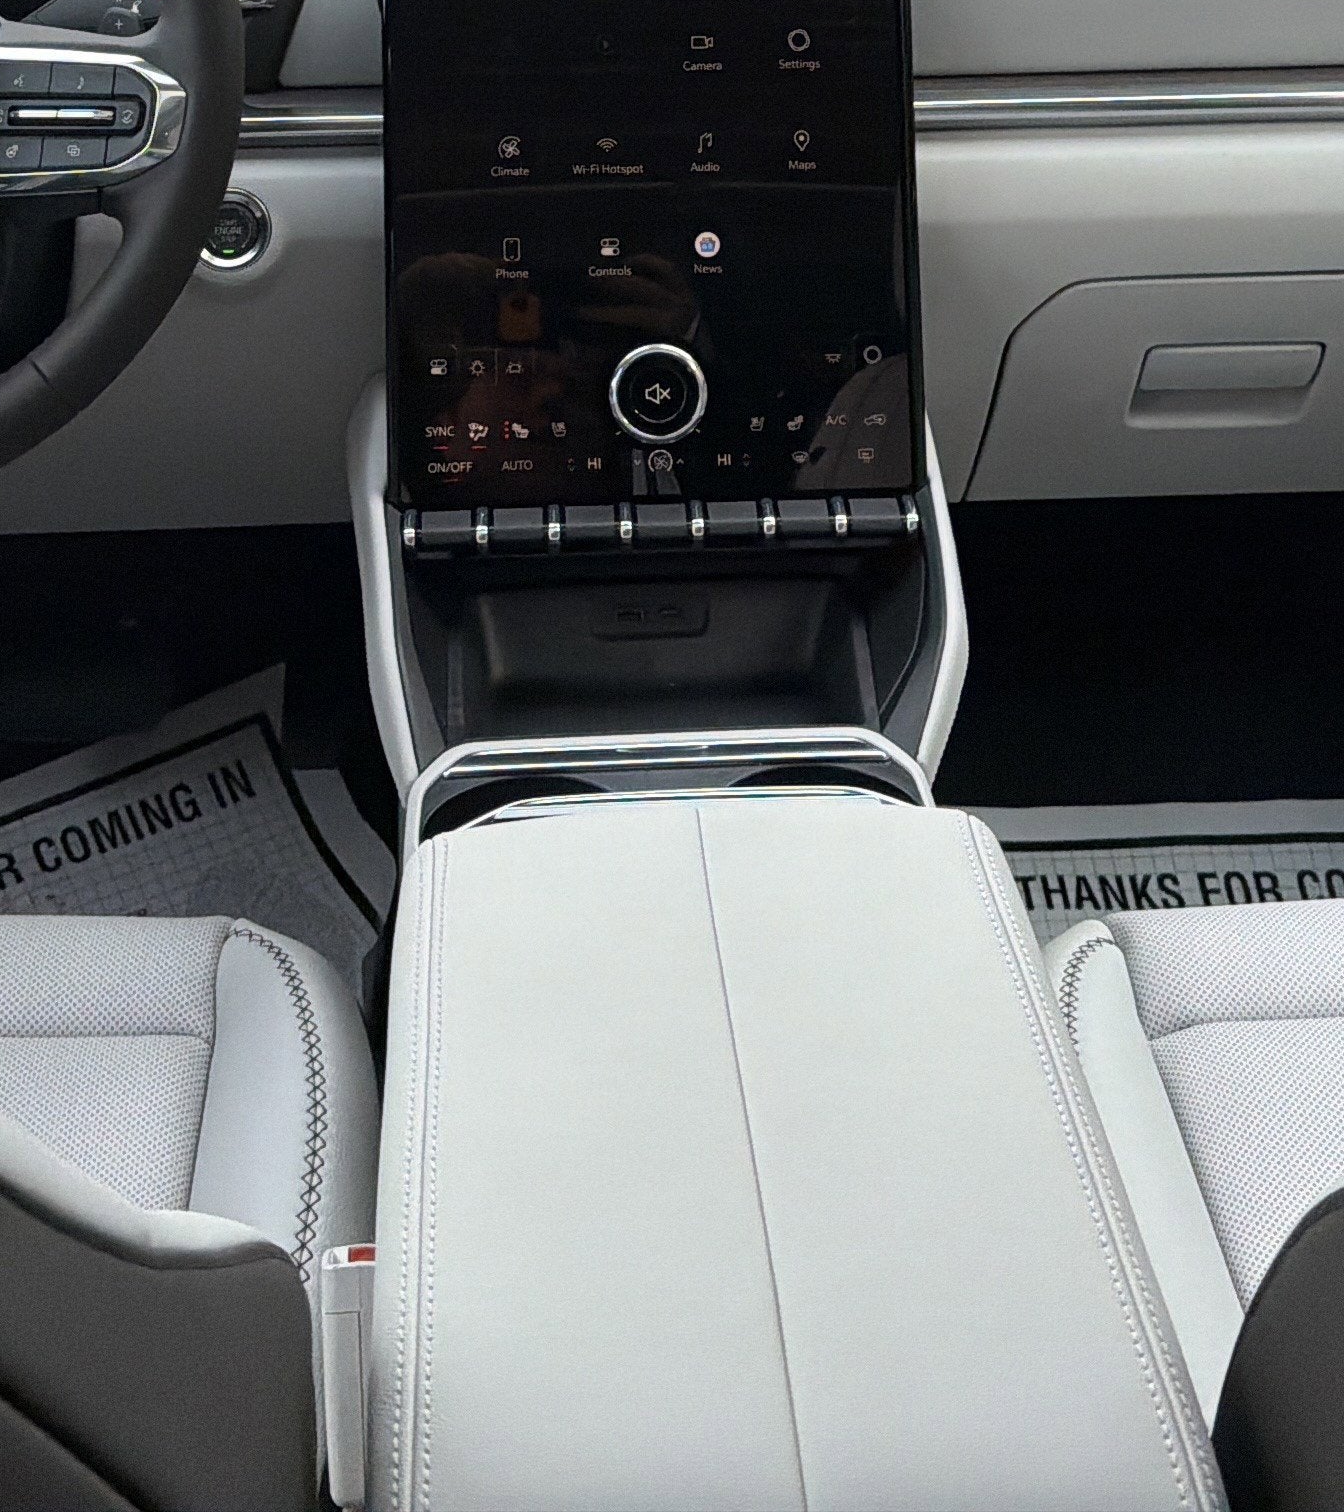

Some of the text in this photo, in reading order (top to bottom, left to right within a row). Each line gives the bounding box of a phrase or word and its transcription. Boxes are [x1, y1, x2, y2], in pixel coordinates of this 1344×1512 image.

[682, 60, 723, 72] Camera
[778, 59, 821, 72] Settings
[490, 166, 530, 177] Climate
[572, 163, 644, 176] Wi-Fi Hotspot
[690, 161, 721, 172] Audio
[788, 160, 817, 172] Maps
[495, 268, 529, 279] Phone
[588, 265, 633, 277] Controls
[693, 263, 723, 274] News
[825, 414, 848, 426] A/C
[424, 426, 456, 437] SYNC
[501, 459, 534, 472] AUTO
[587, 457, 602, 470] HI
[717, 453, 732, 466] HI
[427, 461, 474, 474] ON/OFF
[32, 782, 203, 873] COMING
[207, 759, 257, 809] IN
[1014, 872, 1186, 911] THANKS
[1196, 869, 1284, 906] FOR
